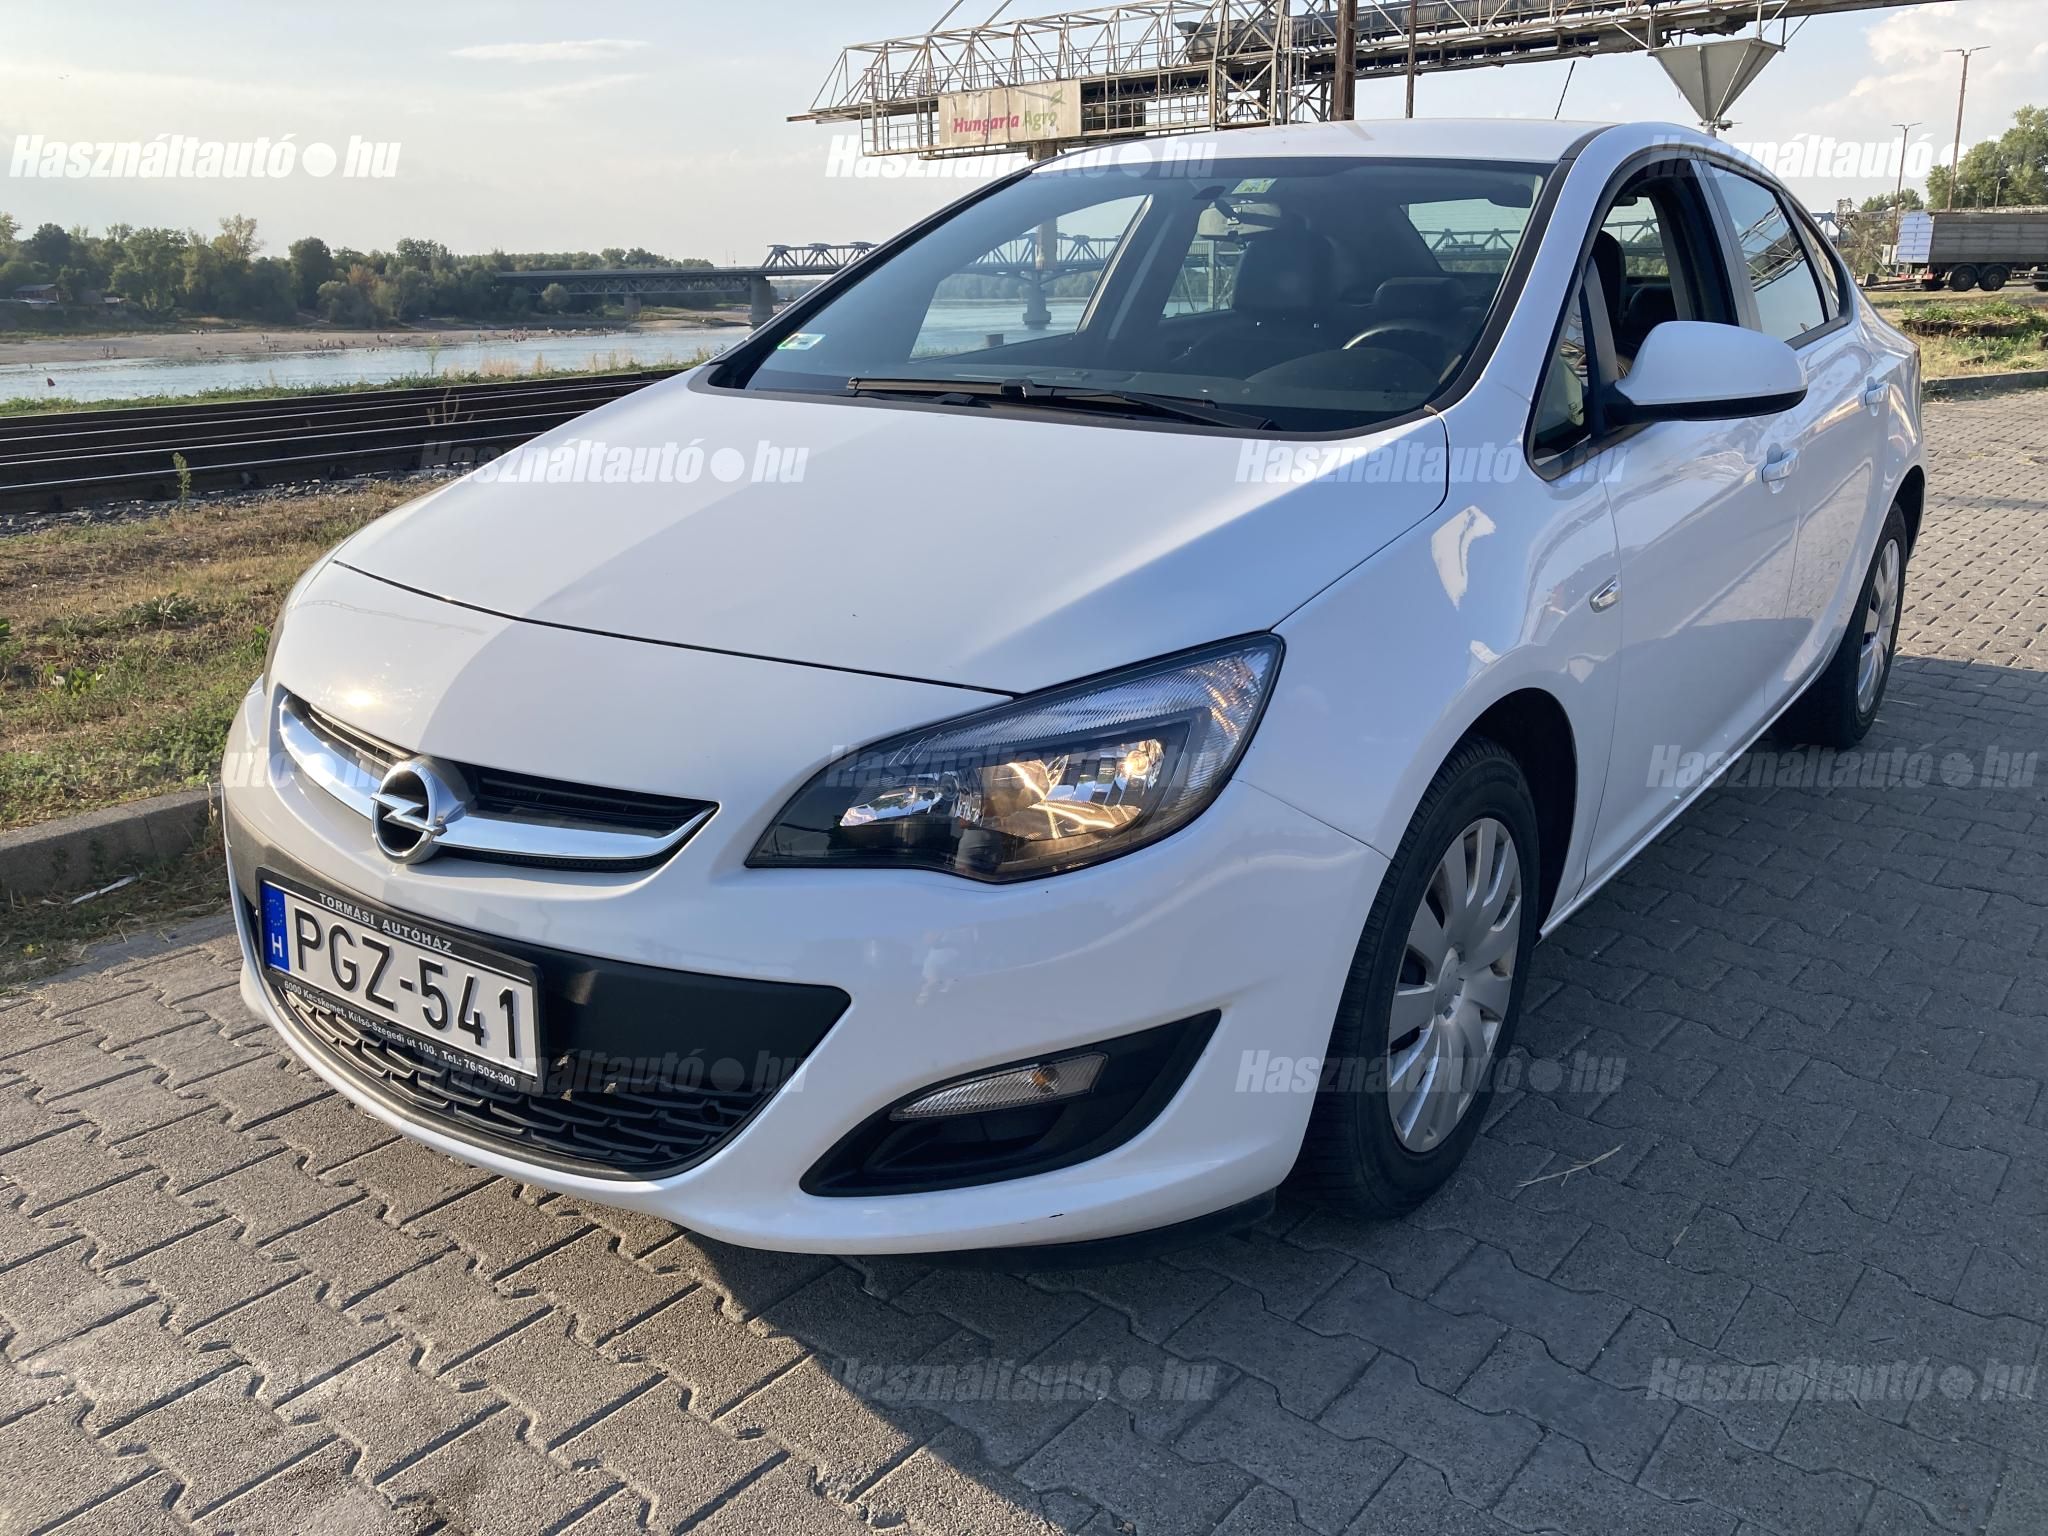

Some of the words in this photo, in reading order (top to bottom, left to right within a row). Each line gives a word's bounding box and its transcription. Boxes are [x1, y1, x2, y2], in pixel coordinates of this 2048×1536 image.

[953, 112, 1019, 135] Hungaria
[1023, 110, 1057, 131] Agro
[271, 933, 283, 958] H
[319, 892, 376, 925] TORMÁSI
[381, 919, 453, 953] AUTÓHÁZ
[294, 905, 518, 1060] PGZ-541
[284, 980, 302, 995] 6000
[418, 1041, 438, 1056] 100.
[441, 1050, 462, 1066] Tel.:
[463, 1058, 516, 1087] 76/502-900
